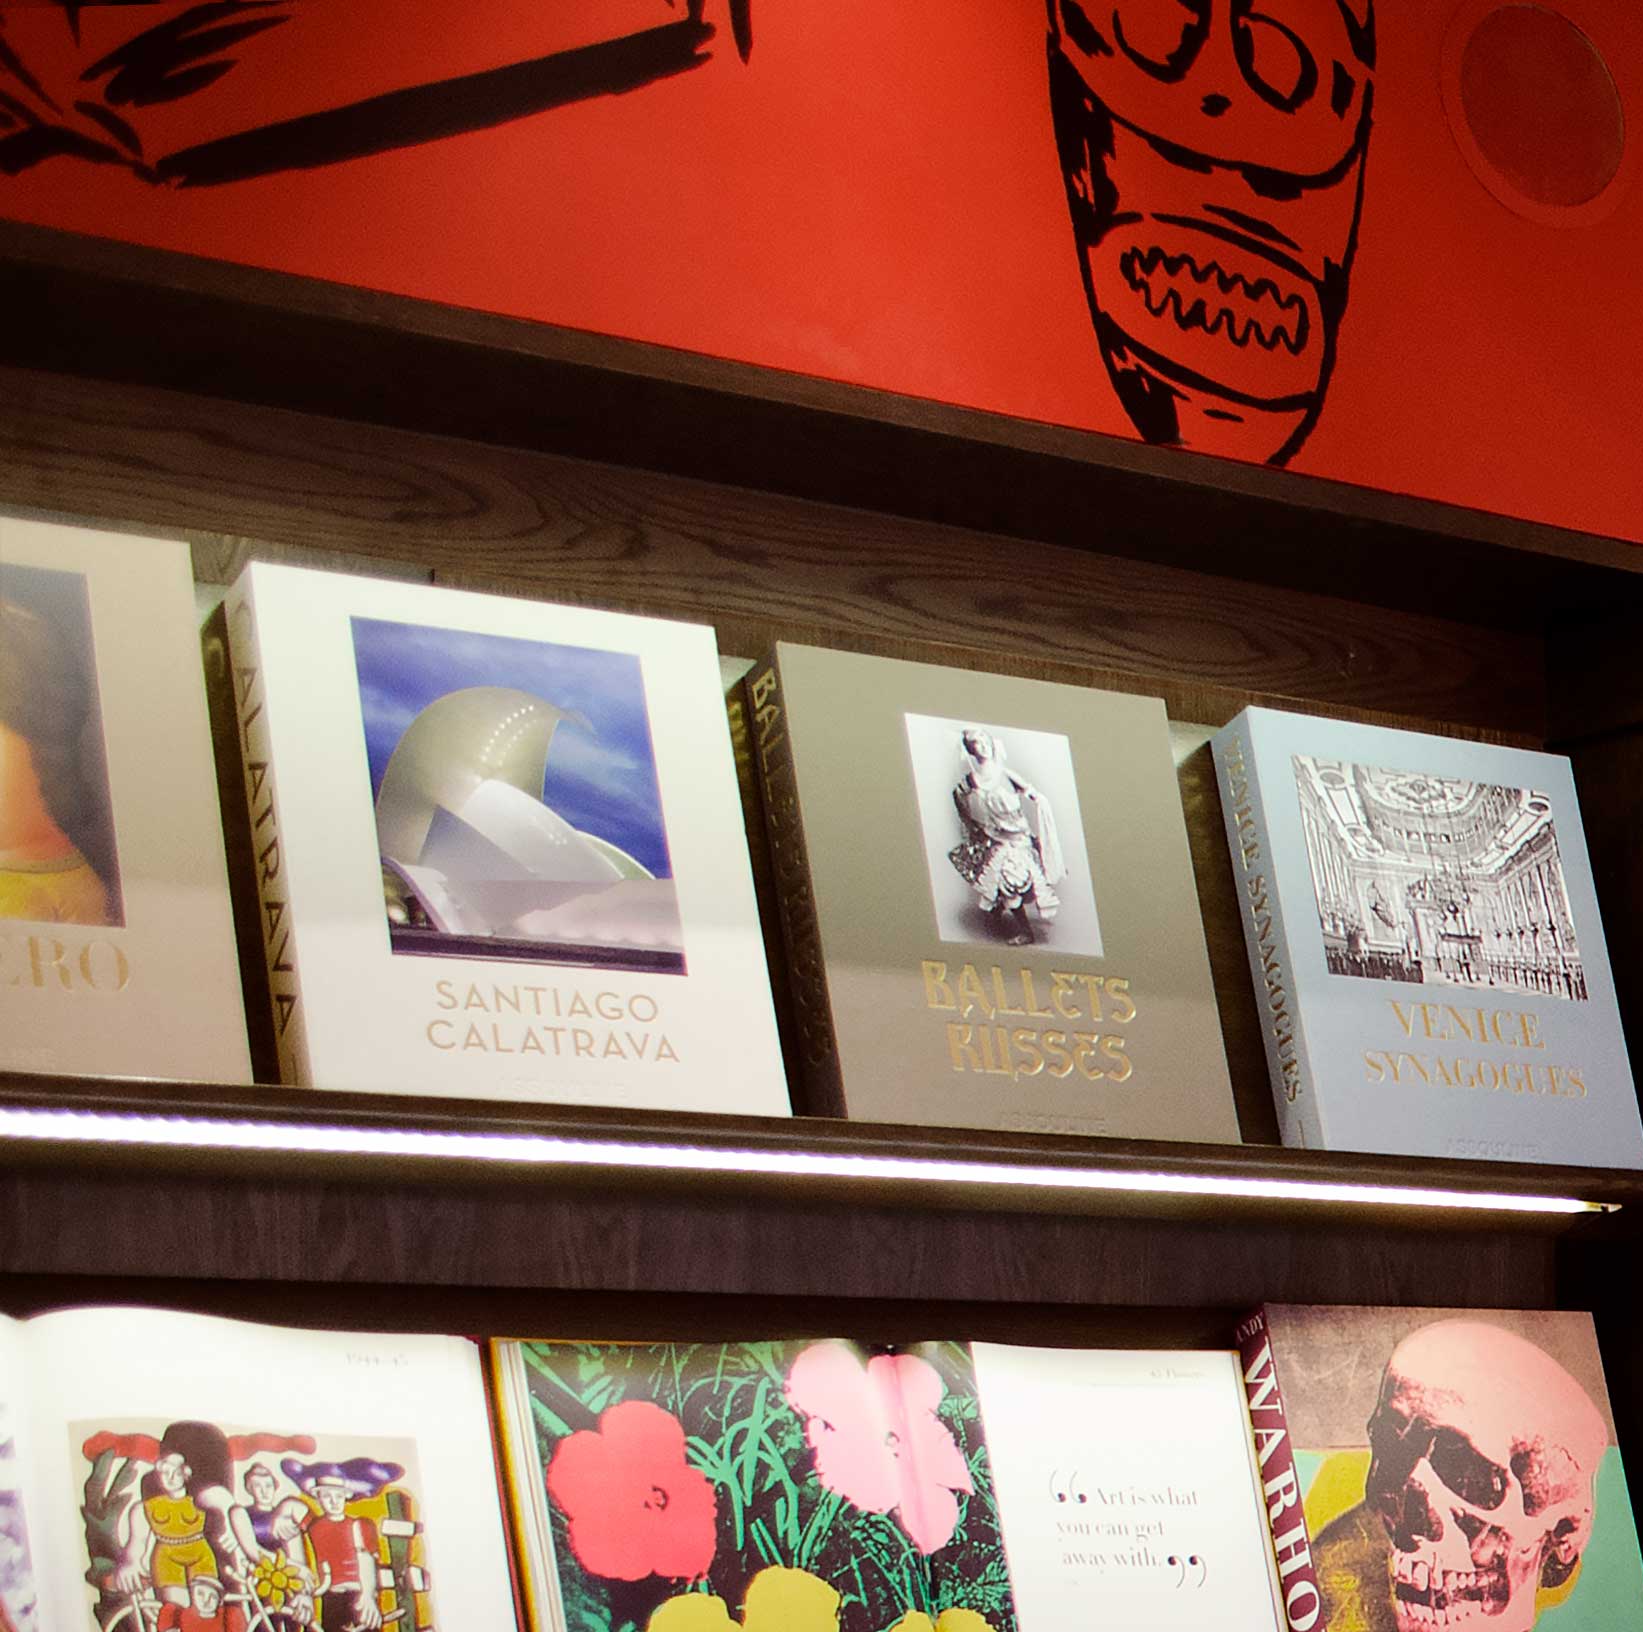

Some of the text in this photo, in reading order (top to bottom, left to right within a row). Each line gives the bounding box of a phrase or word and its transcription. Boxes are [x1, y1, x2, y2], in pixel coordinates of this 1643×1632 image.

[1224, 738, 1302, 1104] VENICE SYNAGOGUES
[435, 980, 660, 1024] SANTIAGO
[922, 959, 1137, 1025] BALLETS
[426, 1019, 681, 1065] CALATRAVA
[1386, 1001, 1545, 1051] VENICE
[946, 1023, 1133, 1084] RUSSES
[1364, 1050, 1588, 1099] SYNAGOGUES
[1236, 1312, 1266, 1344] ANDY
